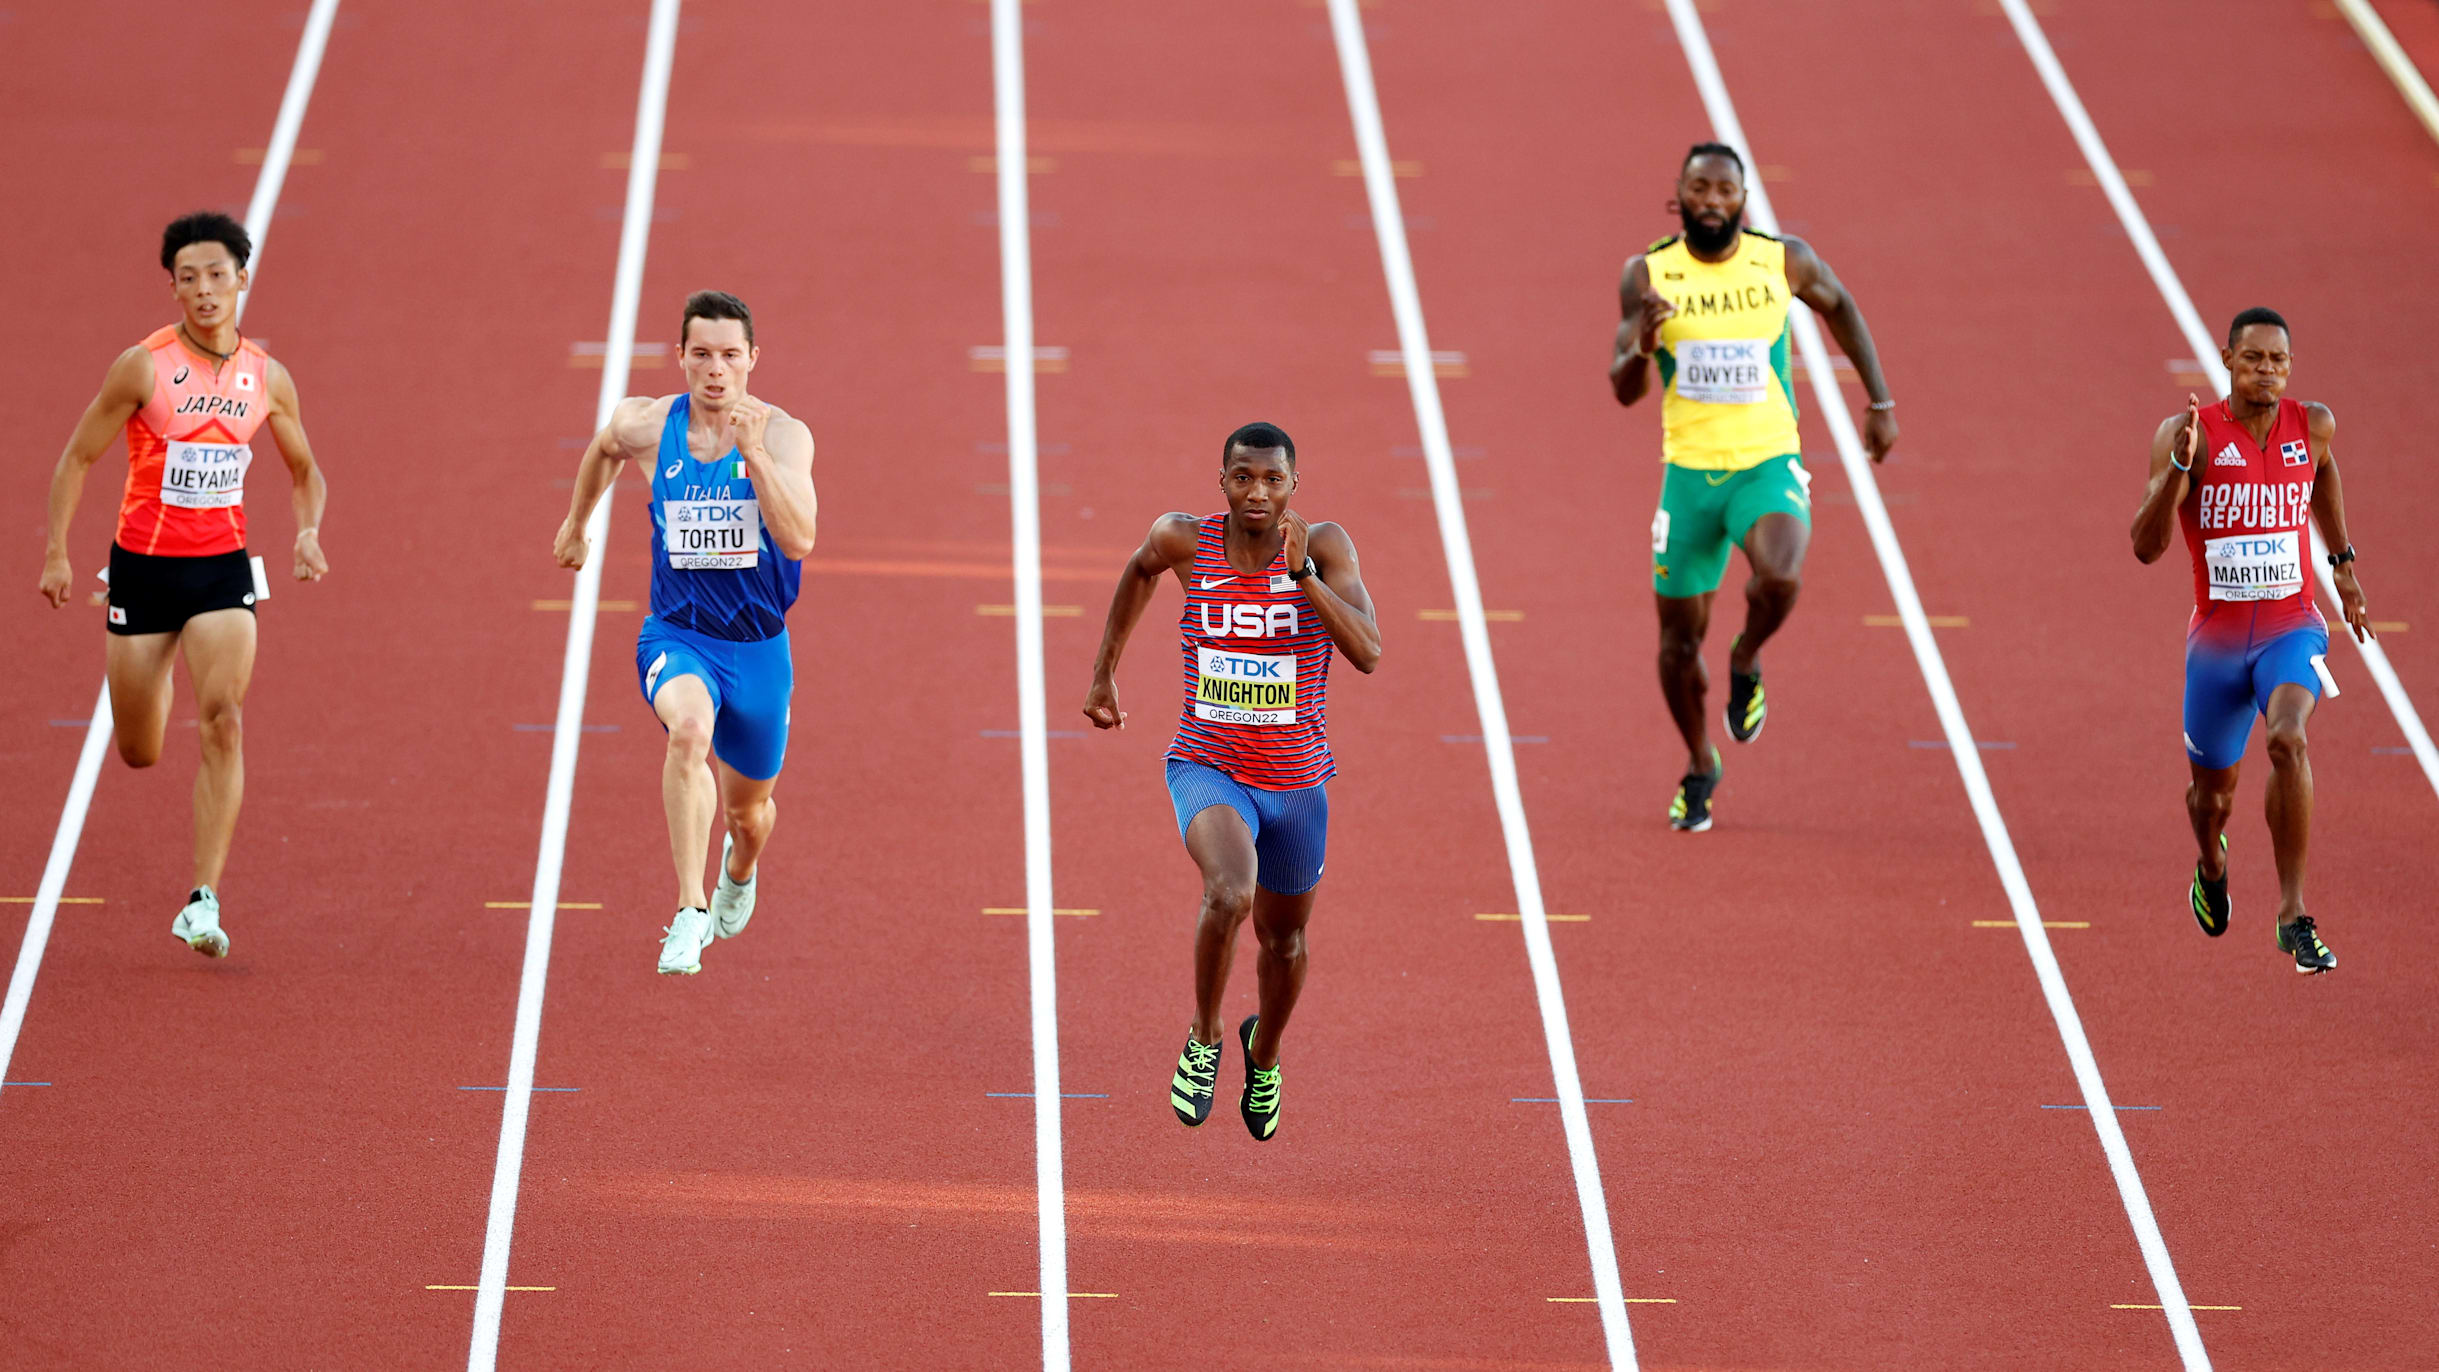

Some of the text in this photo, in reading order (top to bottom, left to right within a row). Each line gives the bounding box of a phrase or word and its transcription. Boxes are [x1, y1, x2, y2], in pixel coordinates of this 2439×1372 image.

[1672, 285, 1776, 318] JAMAICA
[1708, 345, 1754, 359] TDK
[1689, 365, 1759, 384] DWYER
[177, 396, 248, 417] JAPAN
[198, 448, 242, 463] TDK
[2214, 457, 2247, 467] adidas
[170, 467, 239, 488] UEYAMA
[683, 485, 731, 500] ITALIA
[692, 505, 744, 521] TDK
[2200, 503, 2308, 529] REPUBLIC
[680, 528, 744, 549] TORTU
[2235, 538, 2287, 557] TDK
[680, 557, 743, 567] OREGON22
[2214, 561, 2297, 583] MARTÍNEZ
[1200, 602, 1299, 637] USA
[1225, 657, 1280, 677] TDK
[1202, 677, 1290, 705] KNIGHTON
[1209, 709, 1278, 723] OREGON22
